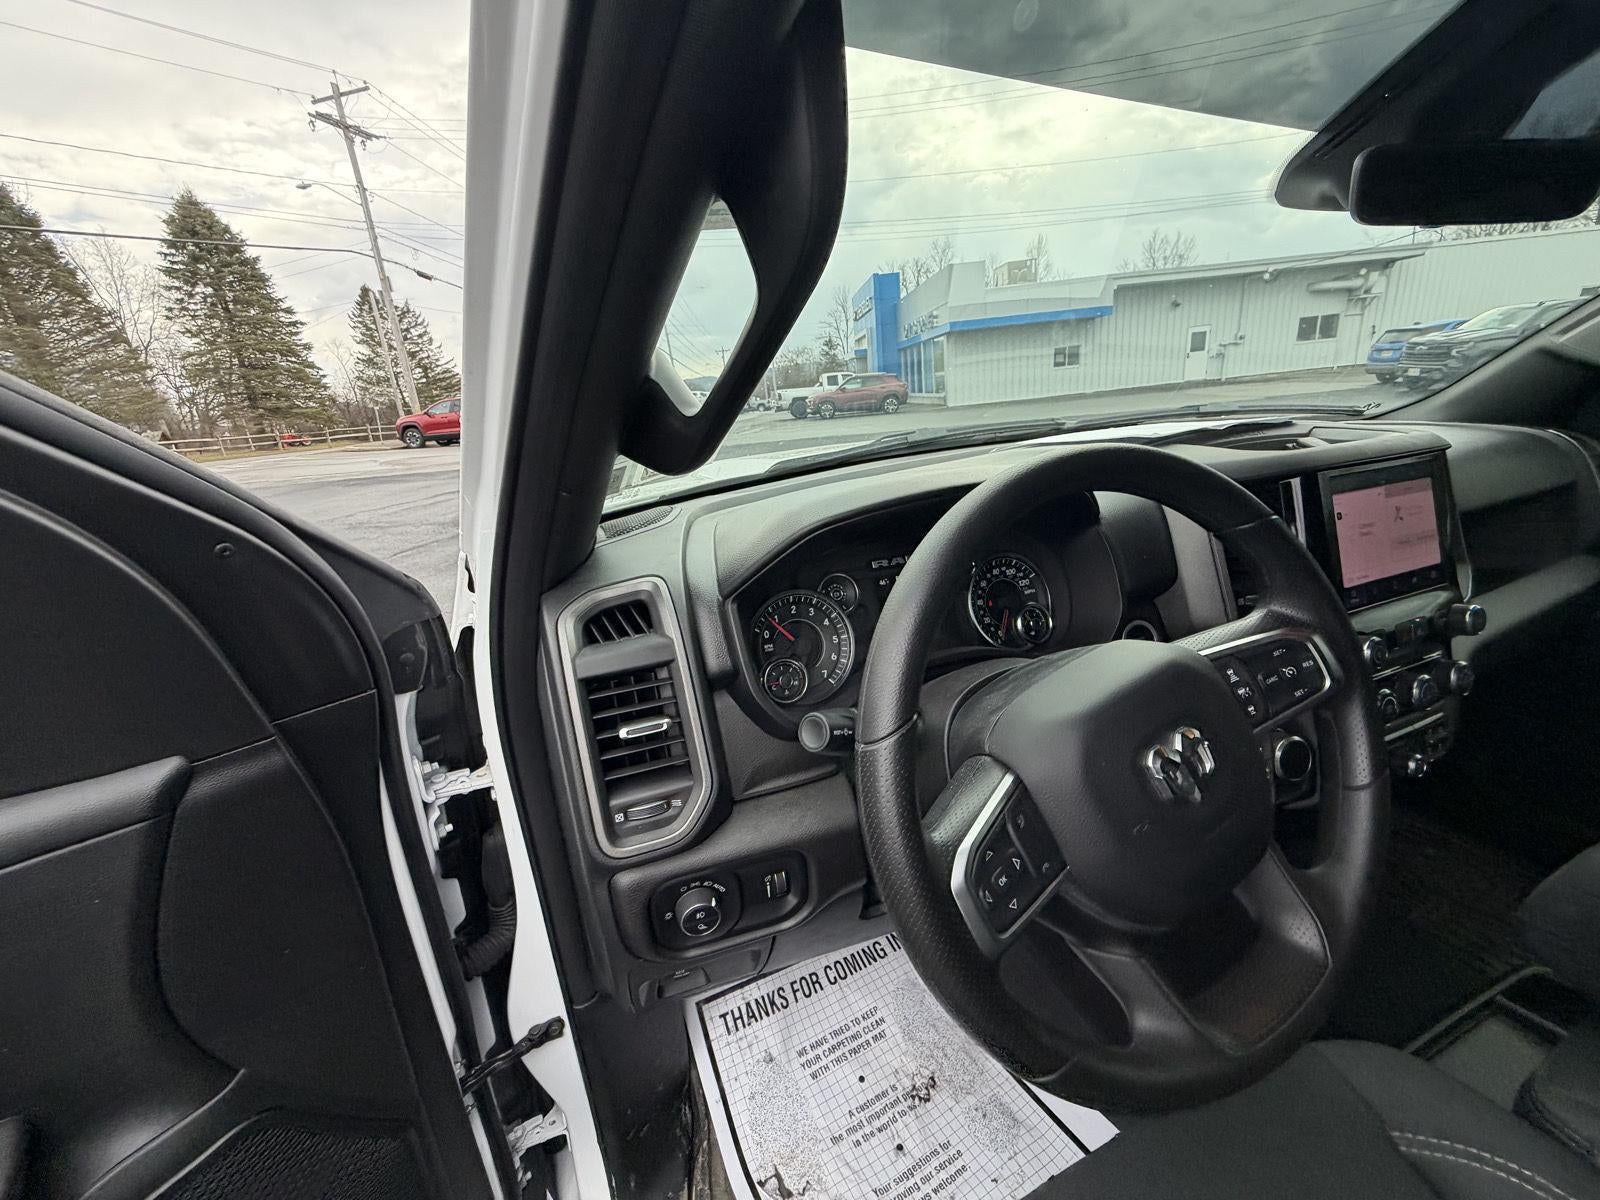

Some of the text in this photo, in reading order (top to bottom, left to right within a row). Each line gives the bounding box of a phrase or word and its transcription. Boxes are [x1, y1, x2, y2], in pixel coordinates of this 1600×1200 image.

[872, 555, 908, 568] RA
[791, 605, 796, 614] 2
[809, 608, 815, 616] 3
[824, 618, 830, 626] 4
[764, 630, 770, 639] 0
[832, 635, 839, 643] 5
[831, 652, 838, 661] 6
[821, 670, 828, 678] 7
[999, 875, 1007, 886] OK
[713, 883, 726, 892] AUTO
[719, 986, 790, 1036] THANKS
[790, 972, 824, 1003] FOR
[824, 941, 888, 986] COMING
[796, 1006, 878, 1058] WE HAVE TRIED TO KEEP
[800, 1016, 886, 1071] YOUR CARPETING CLEAN
[809, 1029, 887, 1081] WITH THIS PAPER MAT
[848, 1083, 899, 1119] A customer is
[830, 1081, 927, 1146] the most important peon
[852, 1138, 862, 1149] in
[861, 1130, 877, 1143] the
[876, 1113, 899, 1134] world
[897, 1109, 907, 1119] to
[872, 1139, 953, 1198] Your suggestions for
[920, 1171, 935, 1186] our
[934, 1148, 964, 1175] service
